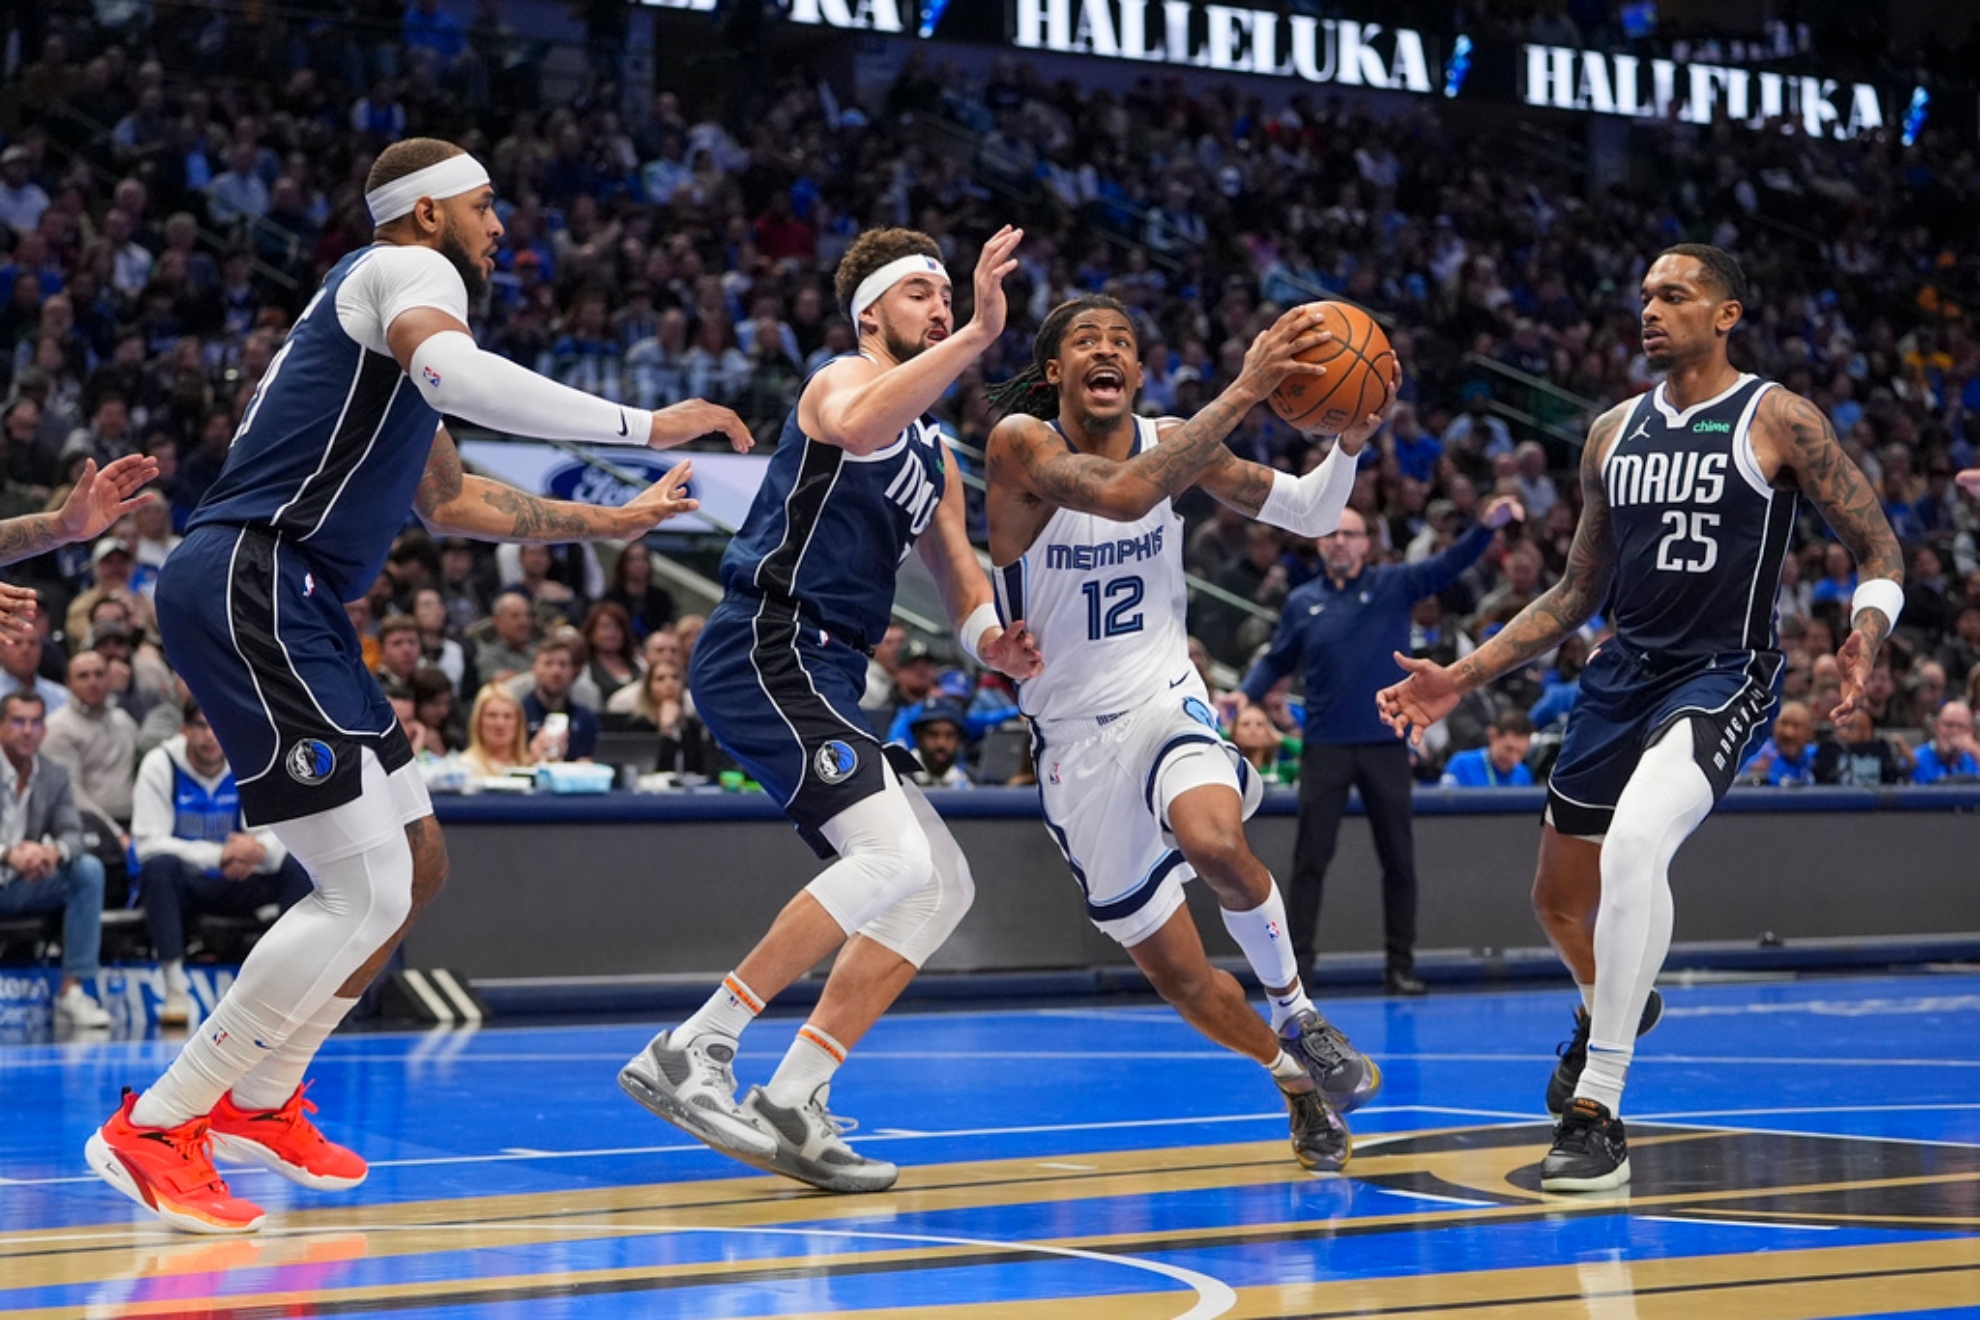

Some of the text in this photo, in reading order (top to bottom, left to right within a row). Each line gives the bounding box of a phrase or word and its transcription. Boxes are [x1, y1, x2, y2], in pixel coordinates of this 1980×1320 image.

[1012, 0, 1433, 93] HALLELUKA
[1692, 420, 1731, 433] chime
[1608, 452, 1729, 508] MAVS
[1046, 525, 1164, 571] MEMPHIS
[1656, 510, 1721, 573] 25
[1082, 575, 1145, 641] 12
